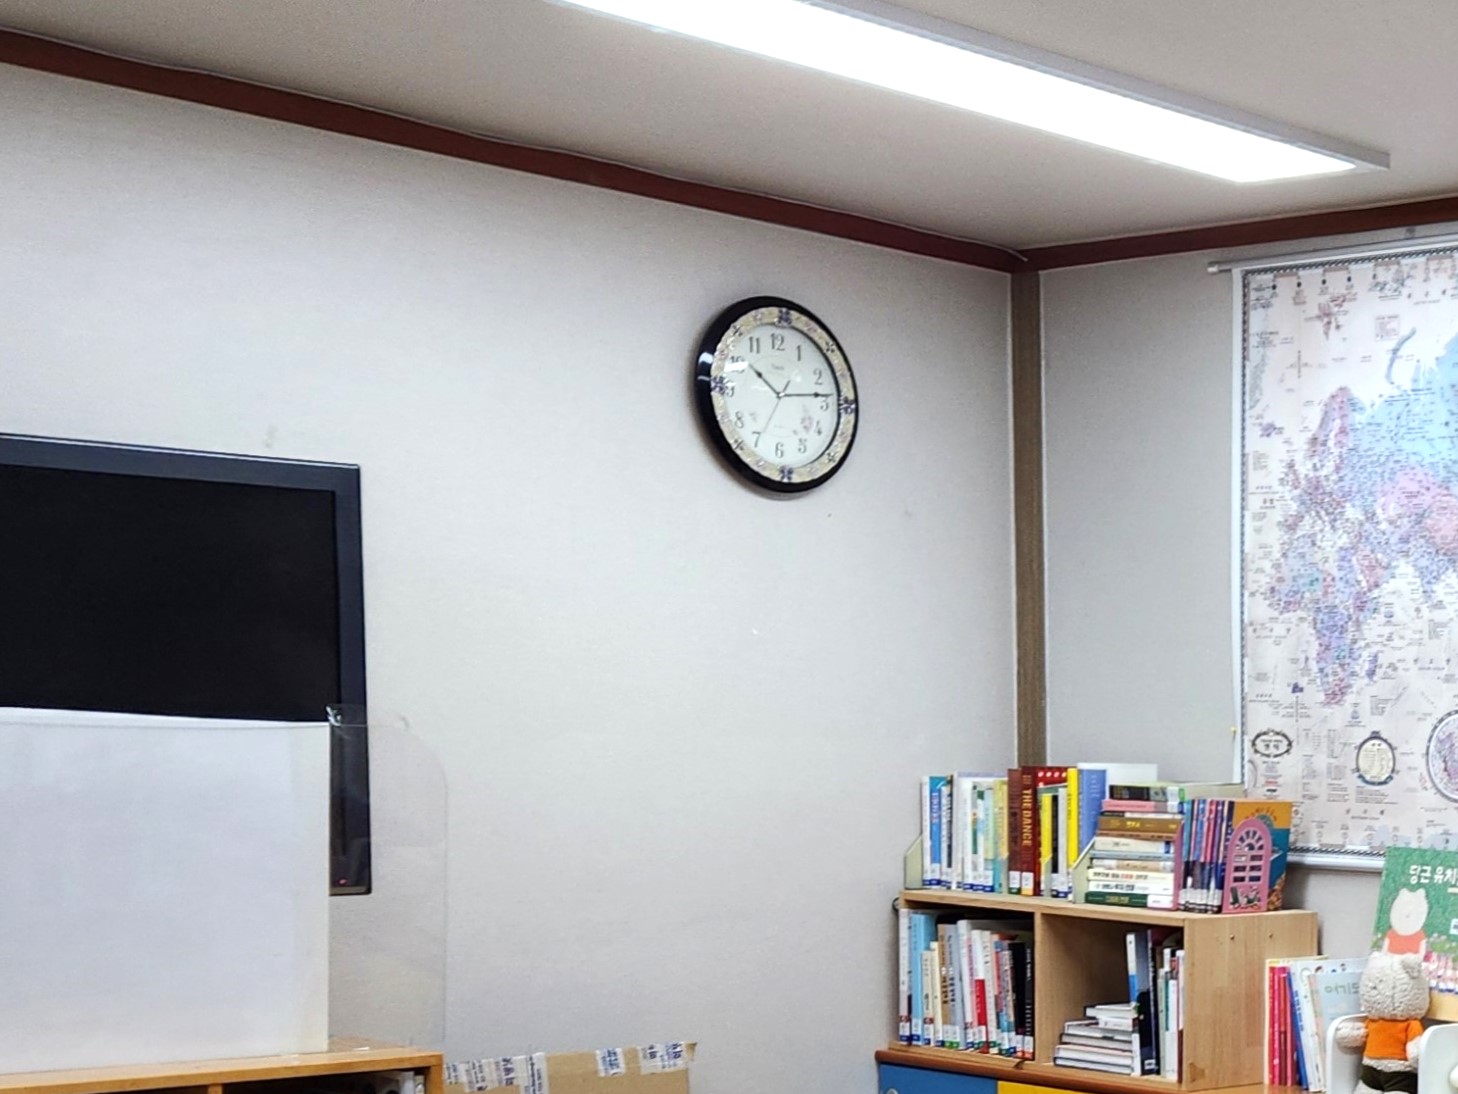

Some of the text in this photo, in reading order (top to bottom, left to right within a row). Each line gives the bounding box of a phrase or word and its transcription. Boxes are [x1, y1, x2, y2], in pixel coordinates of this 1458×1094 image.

[749, 336, 761, 354] 11
[770, 333, 785, 352] 12
[796, 345, 802, 362] 1
[813, 368, 823, 385] 2
[735, 411, 744, 429] 8
[815, 420, 823, 436] 4
[752, 431, 761, 448] 7
[798, 438, 807, 454] 5
[775, 442, 784, 459] 6
[1022, 788, 1033, 847] THE DANCE
[1409, 865, 1432, 884] 당근
